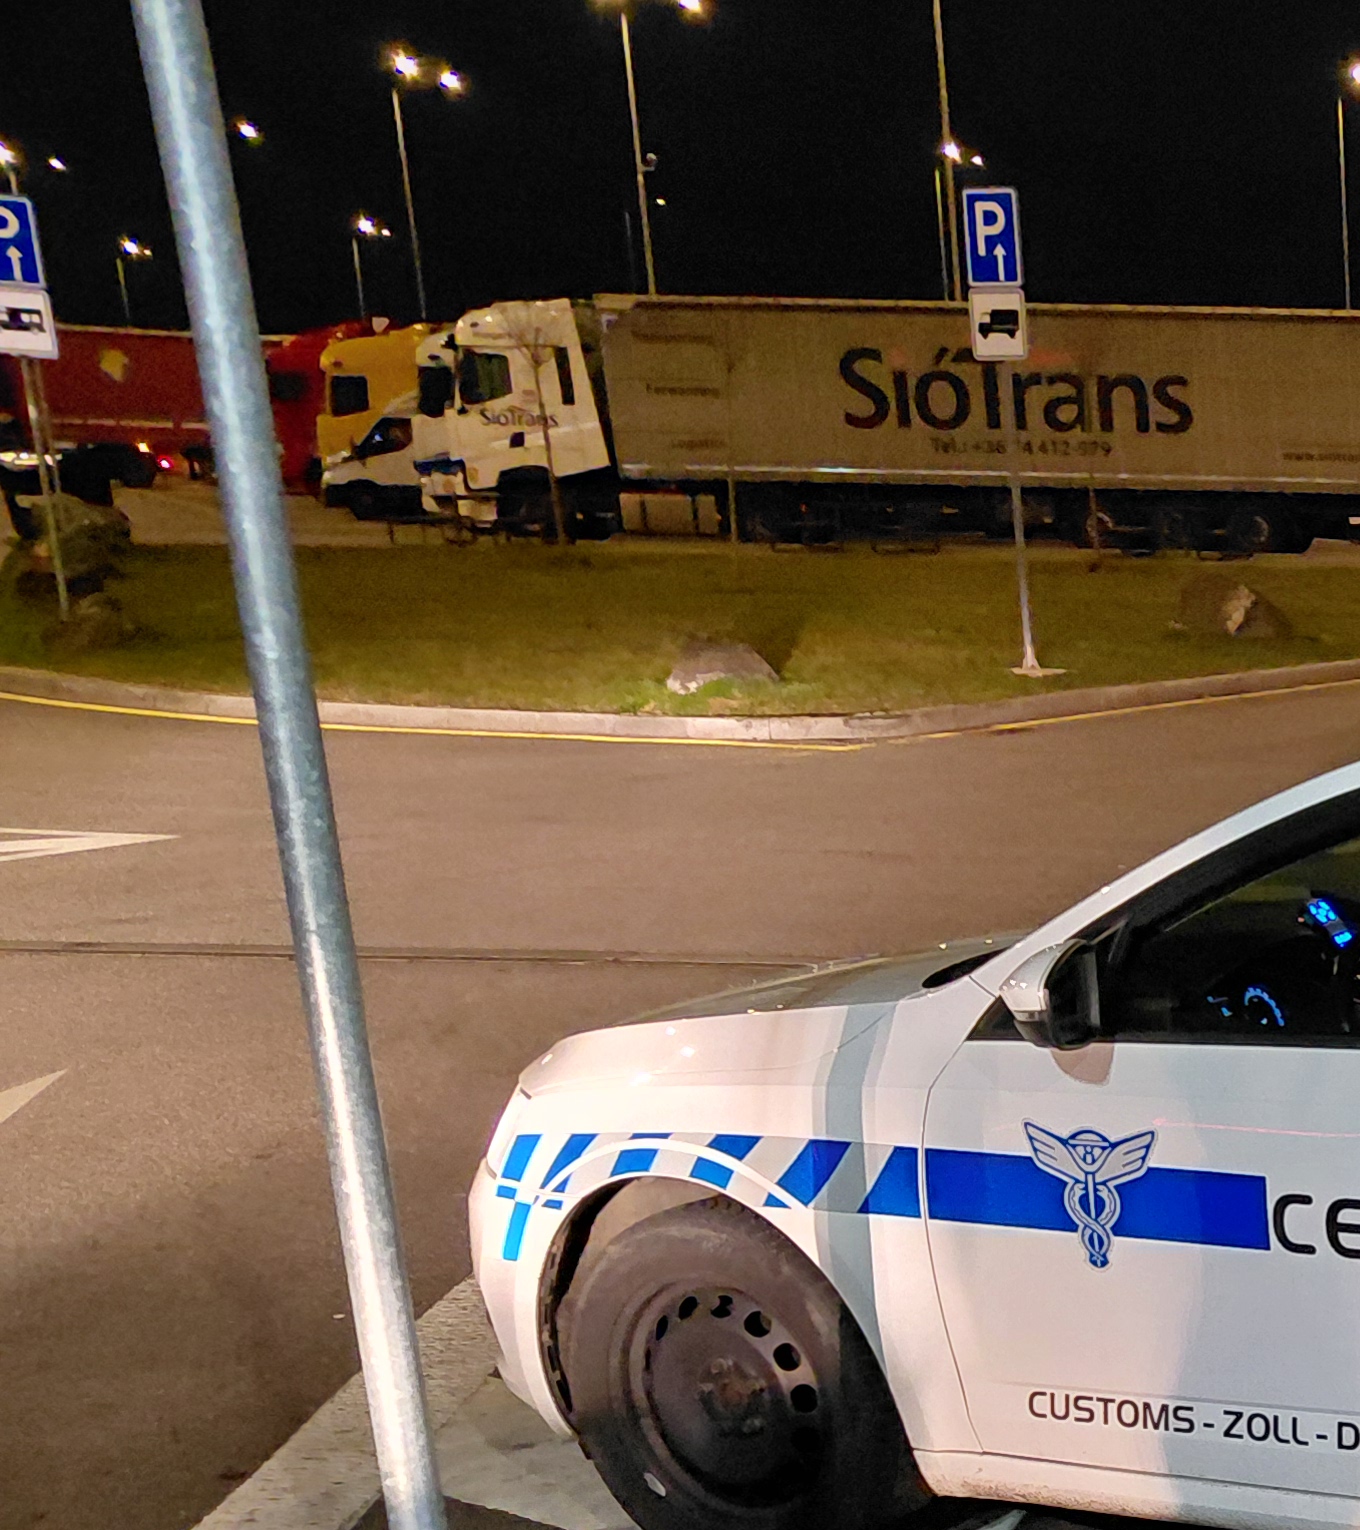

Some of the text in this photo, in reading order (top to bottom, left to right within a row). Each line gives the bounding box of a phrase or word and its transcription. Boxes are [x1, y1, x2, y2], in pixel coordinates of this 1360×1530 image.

[973, 200, 1006, 257] P
[1028, 1391, 1196, 1434] CUSTOMS
[1223, 1409, 1309, 1447] ZOLL
